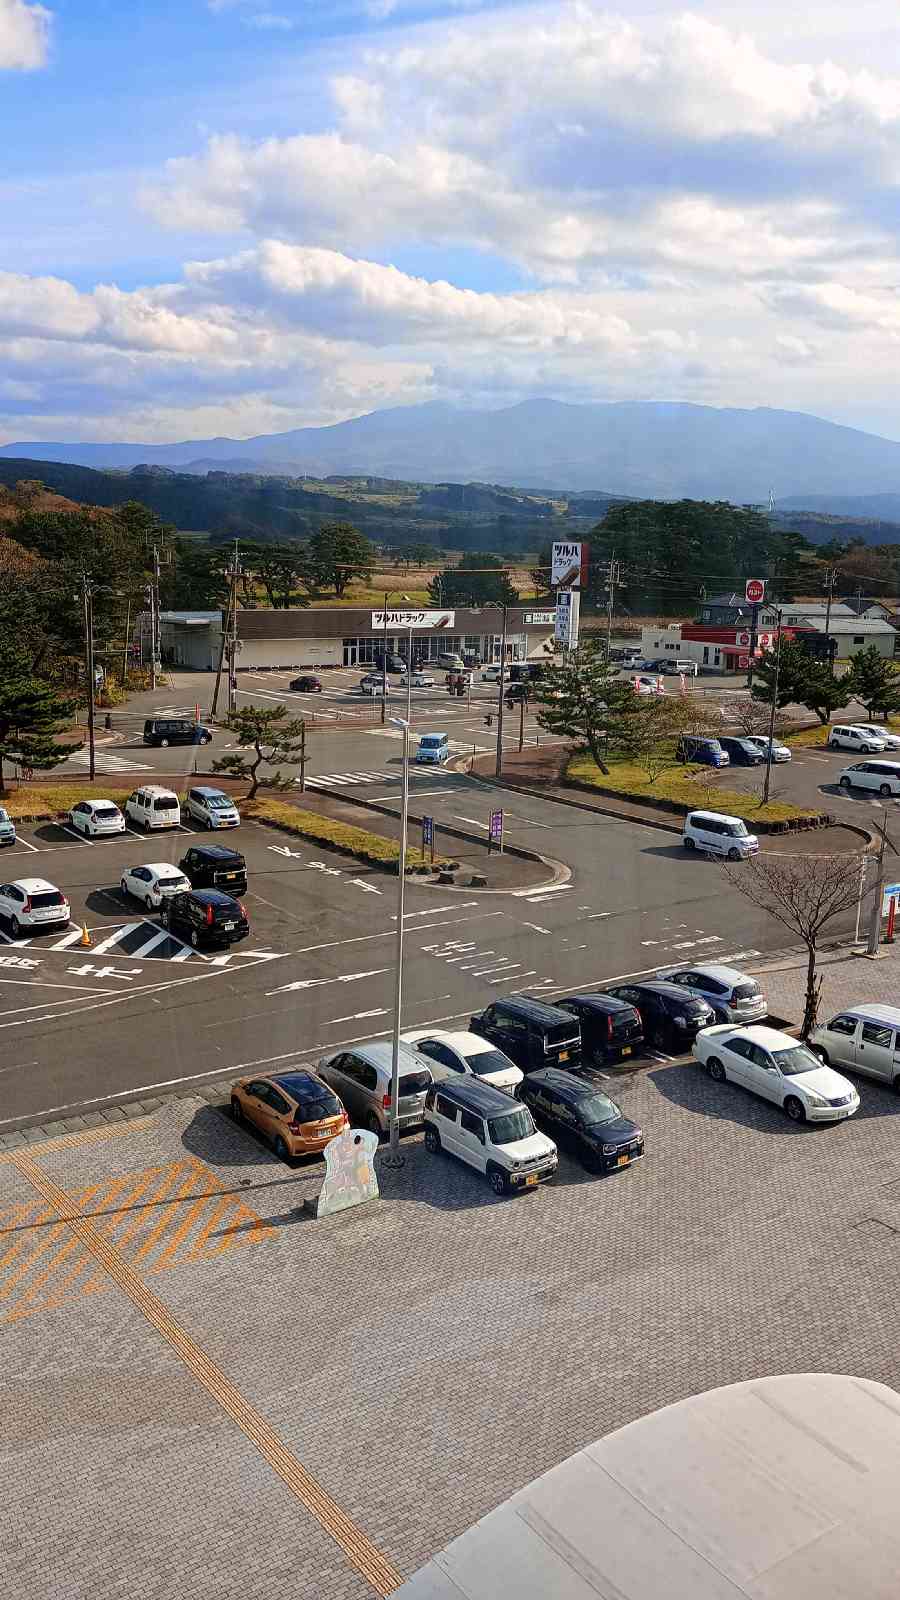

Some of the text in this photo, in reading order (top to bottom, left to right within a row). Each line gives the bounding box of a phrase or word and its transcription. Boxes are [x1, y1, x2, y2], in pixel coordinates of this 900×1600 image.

[554, 545, 579, 557] ツルハ
[374, 612, 428, 623] ツルハドラッグ
